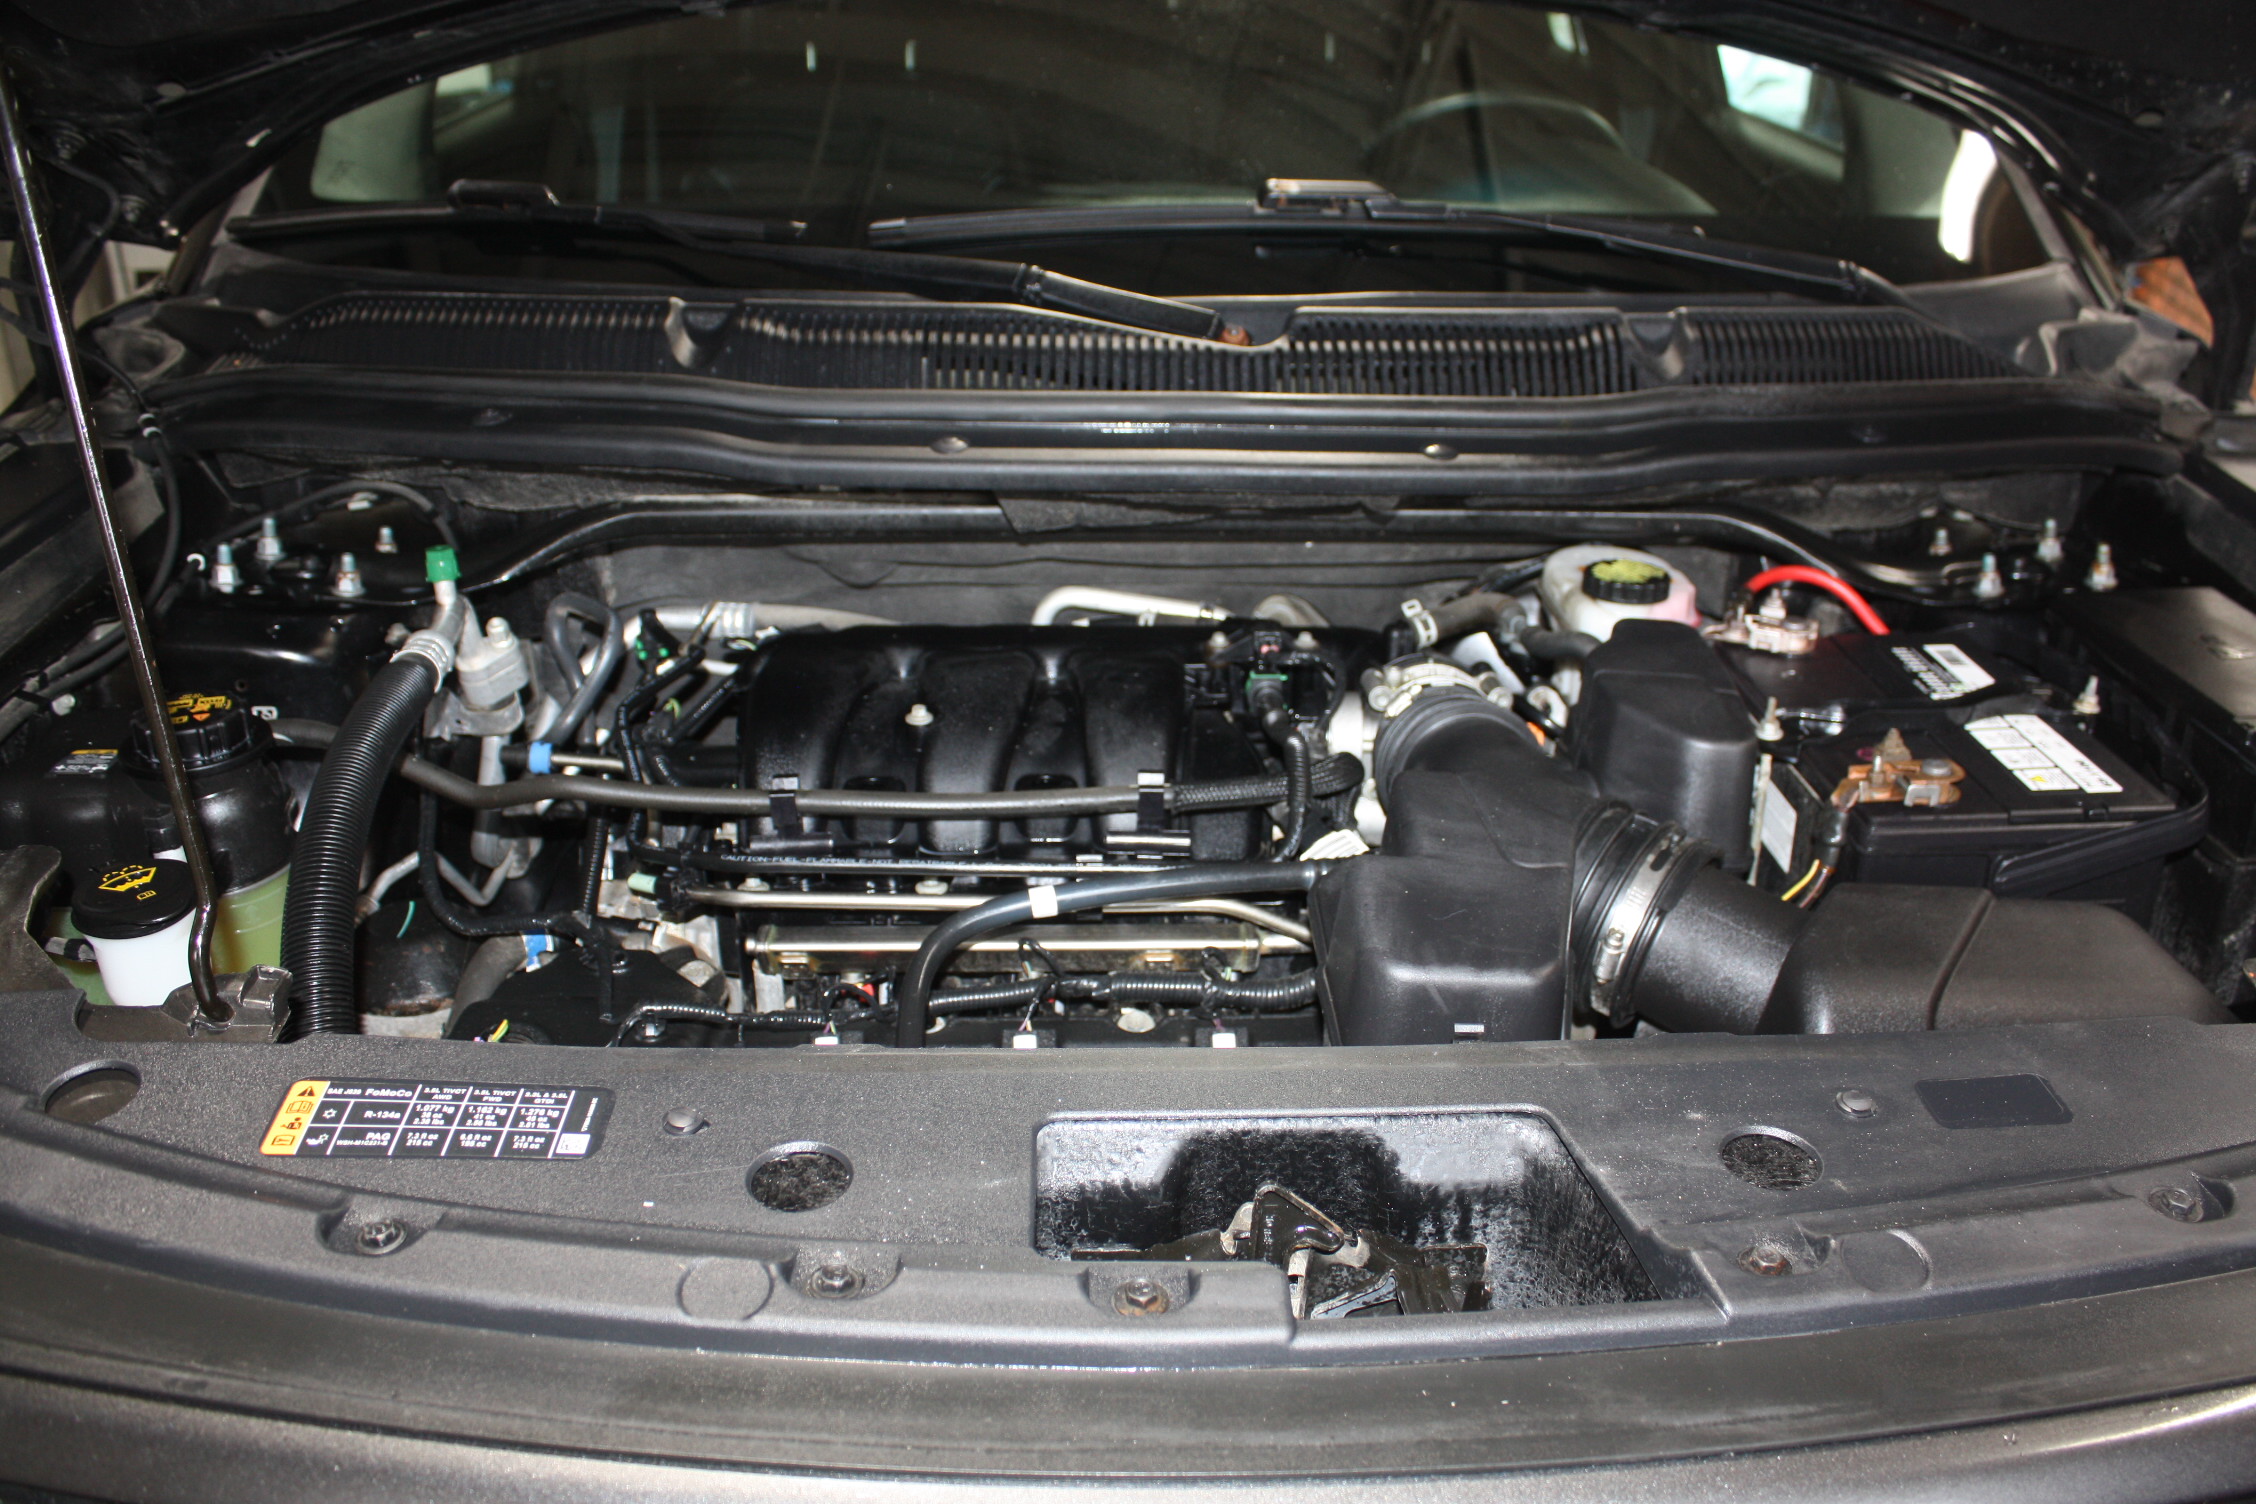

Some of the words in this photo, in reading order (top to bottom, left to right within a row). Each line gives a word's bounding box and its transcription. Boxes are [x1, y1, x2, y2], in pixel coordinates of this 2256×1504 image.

[365, 1088, 413, 1097] FoMoCo
[415, 1104, 442, 1112] 1.077
[442, 1105, 456, 1114] kg
[468, 1106, 494, 1114] 1.162
[494, 1107, 508, 1116] kg
[546, 1109, 560, 1118] kg
[363, 1110, 401, 1119] R-134a
[365, 1132, 391, 1140] PAG
[420, 1132, 428, 1140] fl
[474, 1133, 481, 1141] fl
[526, 1135, 534, 1143] fl
